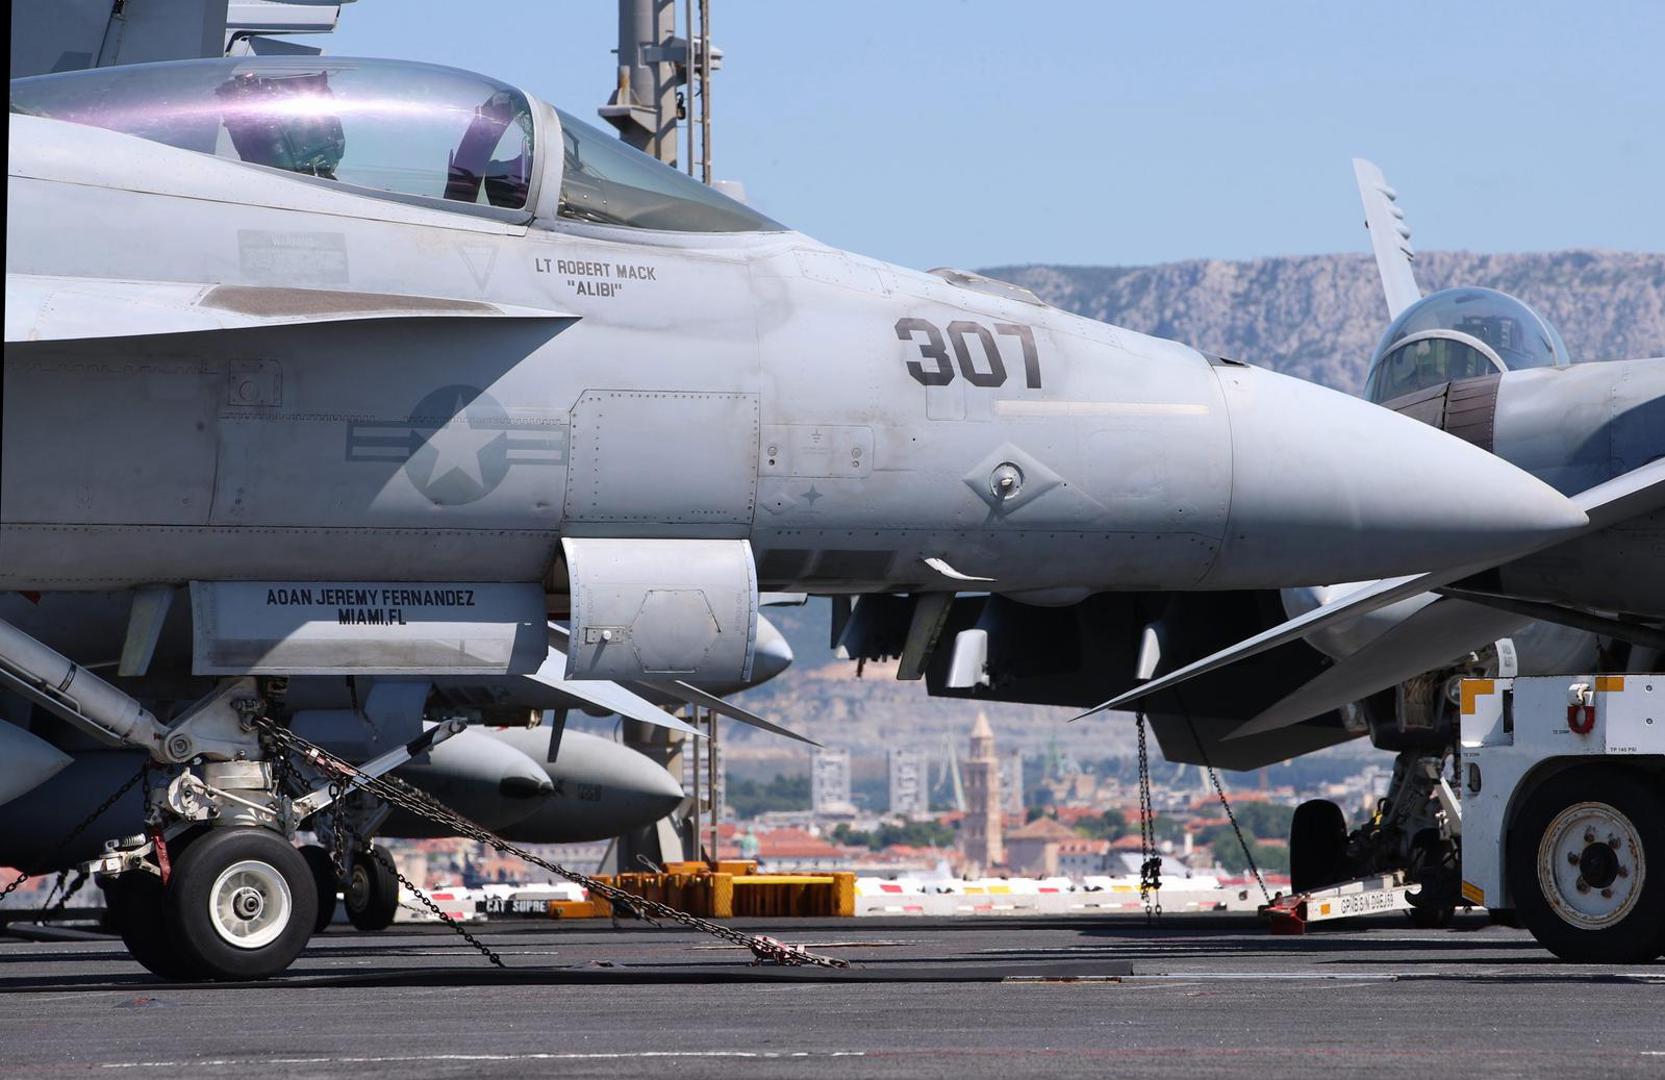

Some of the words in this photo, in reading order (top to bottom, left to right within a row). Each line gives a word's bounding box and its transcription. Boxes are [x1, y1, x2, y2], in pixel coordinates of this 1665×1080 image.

[535, 257, 552, 273] LT
[557, 259, 611, 278] ROBERT
[616, 264, 656, 281] MACK
[567, 279, 622, 298] "ALIBI"
[894, 317, 1042, 389] 307
[316, 588, 379, 606] JEREMY
[382, 589, 476, 607] FERNANDEZ
